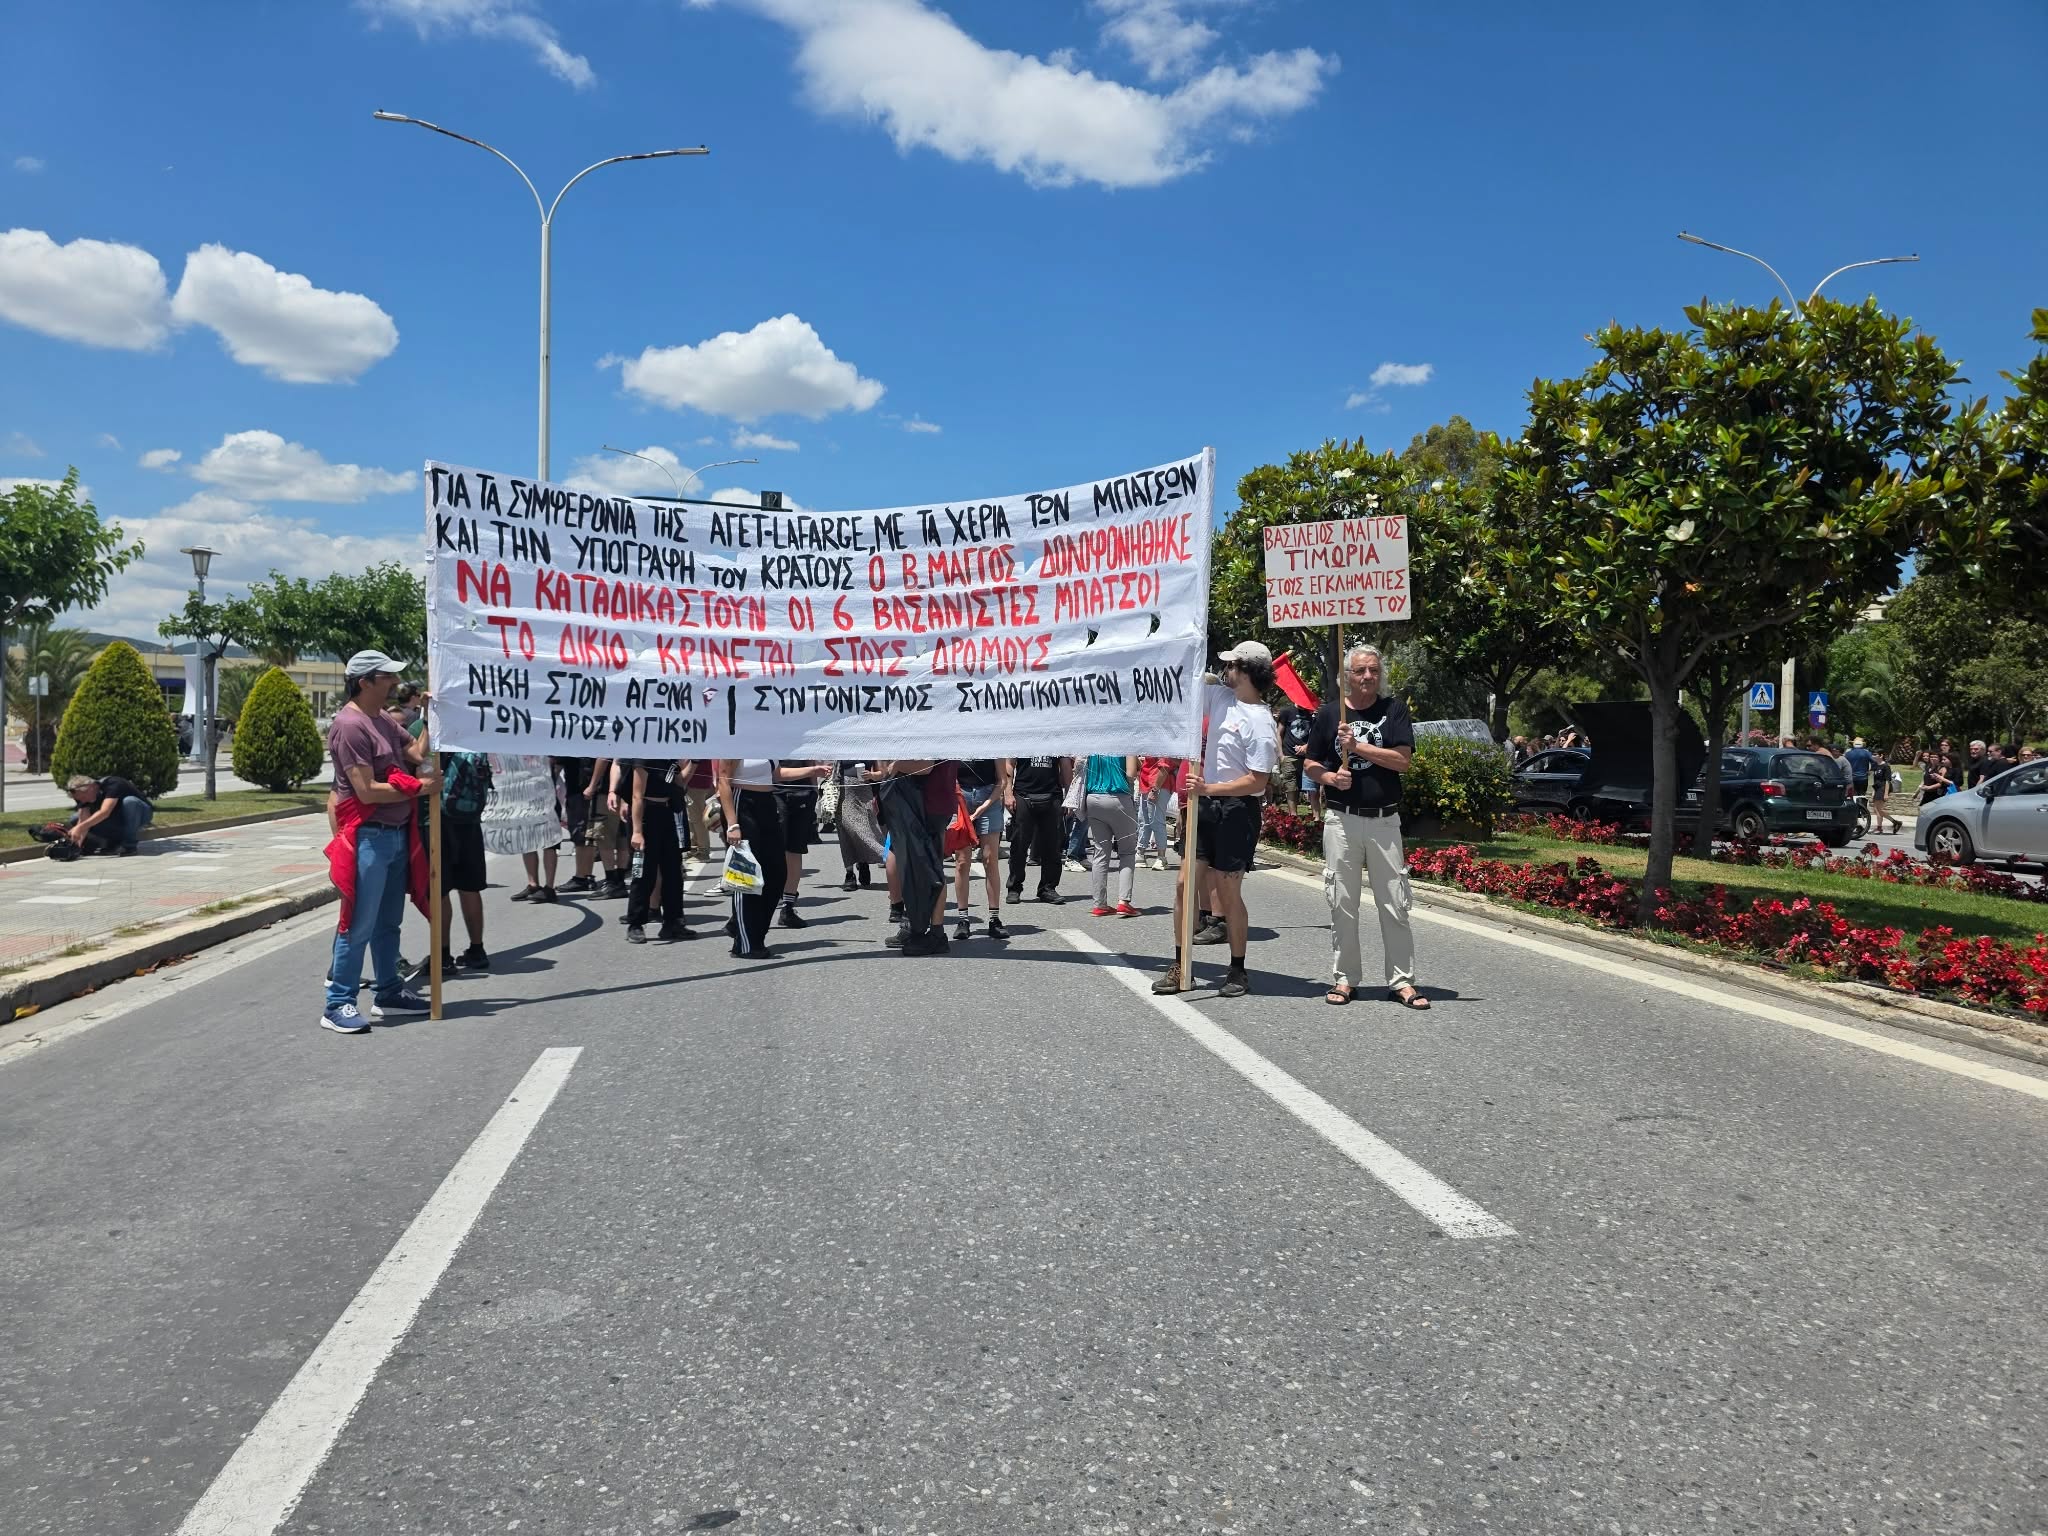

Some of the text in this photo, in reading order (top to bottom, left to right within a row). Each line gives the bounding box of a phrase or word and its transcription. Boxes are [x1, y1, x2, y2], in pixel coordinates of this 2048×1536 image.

[432, 468, 471, 509] ΓΙΑ
[476, 473, 501, 516] ΤΑ
[507, 480, 637, 539] ΣΥΜΦΕΡΟΝΤΑ
[649, 505, 690, 543] ΤΗΣ
[874, 512, 908, 552] ΜΕ
[917, 510, 940, 547] ΤΑ
[944, 504, 1011, 546] ΧΕΡΙΑ
[1024, 491, 1070, 528] ΤΩΝ
[1093, 462, 1197, 517] ΜΠΑΤΣΩΝ
[436, 514, 478, 554] ΚΑΙ
[490, 521, 551, 564] ΤΗΝ
[570, 535, 695, 584] ΥΠΟΓΡΑΦΗ
[708, 566, 747, 590] ΤΟΥ
[761, 553, 855, 590] ΚΡΑΤΟΥΣ
[868, 554, 885, 591] Ο
[1039, 513, 1193, 579] ΔΟΛΟΦΟΝΗΘΗΚΕ
[1265, 516, 1406, 551] ΒΑΣΙΛΕΙΟΣ ΜΑΓΓΟΣ
[1284, 543, 1380, 571] ΤΙΜΩΡΙΑ
[457, 559, 1160, 633] ΝΑ ΚΑΤΑΔΙΚΑΣΤΟΥΝ ΟΙ 6 ΒΑΣΑΝΙΣΤΕΣ ΜΠΑΤΣΟΙ
[1266, 569, 1406, 598] ΣΤΟΥΣ ΕΓΚΛΗΜΑΤΙΕΣ
[1273, 595, 1406, 623] ΒΑΣΑΝΙΣΤΕΣ ΤΟΥ
[488, 616, 1052, 679] ΤΟ ΔΙΚΙΟ ΚΡΙΝΕΤΑΙ ΣΤΟΥΣ ΔΡΟΜΟΥΣ
[468, 664, 693, 711] ΝΙΚΗ ΣΤΟΝ ΑΓΩΝΑ
[754, 666, 1184, 714] ΣΥΝΤΟΝΙΣΜΟΣ ΣΥΛΛΟΓΙΚΟΤΗΤΩΝ ΒΟΛΟΥ
[467, 700, 708, 744] ΤΩΝ ΠΡΟΣΦΥΓΙΚΩΝ
